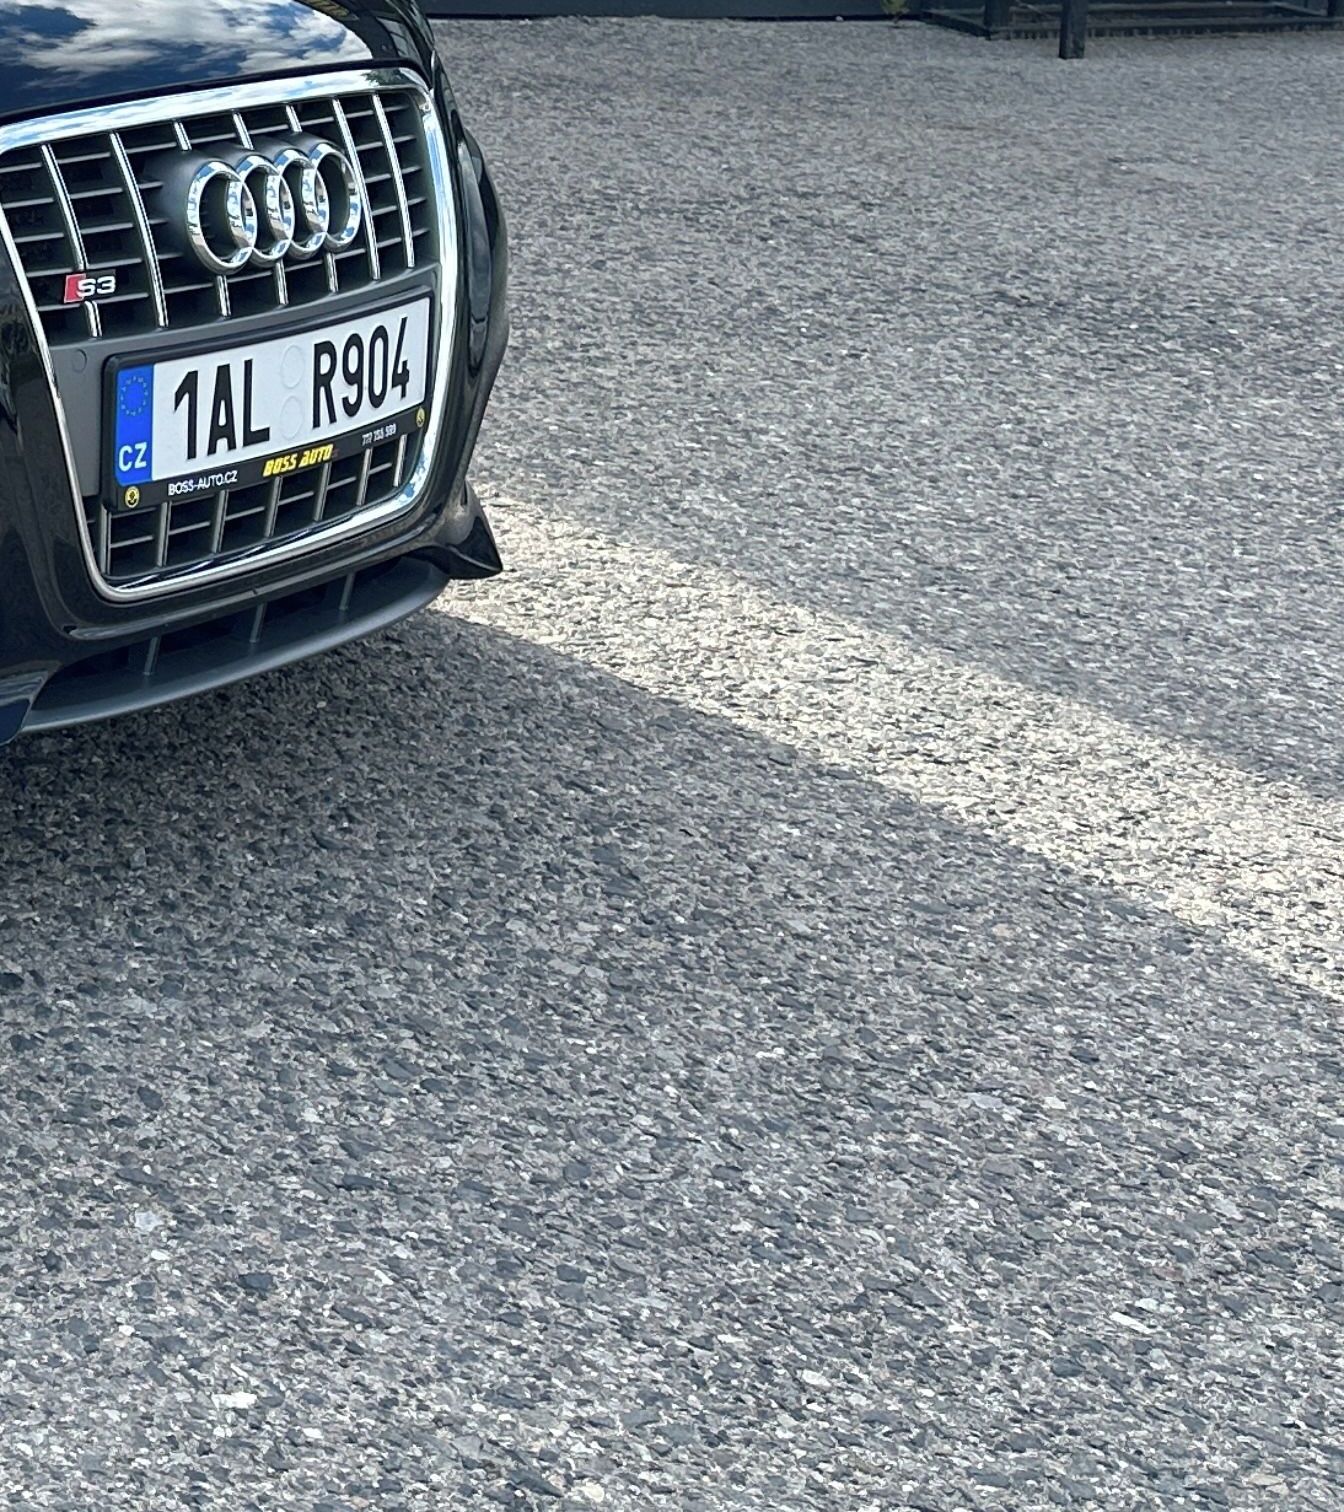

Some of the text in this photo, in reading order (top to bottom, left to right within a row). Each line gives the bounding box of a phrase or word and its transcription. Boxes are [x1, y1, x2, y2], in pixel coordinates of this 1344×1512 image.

[76, 275, 117, 297] S3
[173, 316, 410, 461] 1AL R904
[118, 441, 148, 472] CZ
[263, 444, 334, 477] BOSS AUTO
[168, 470, 238, 496] BOSS-AUTO.CZ
